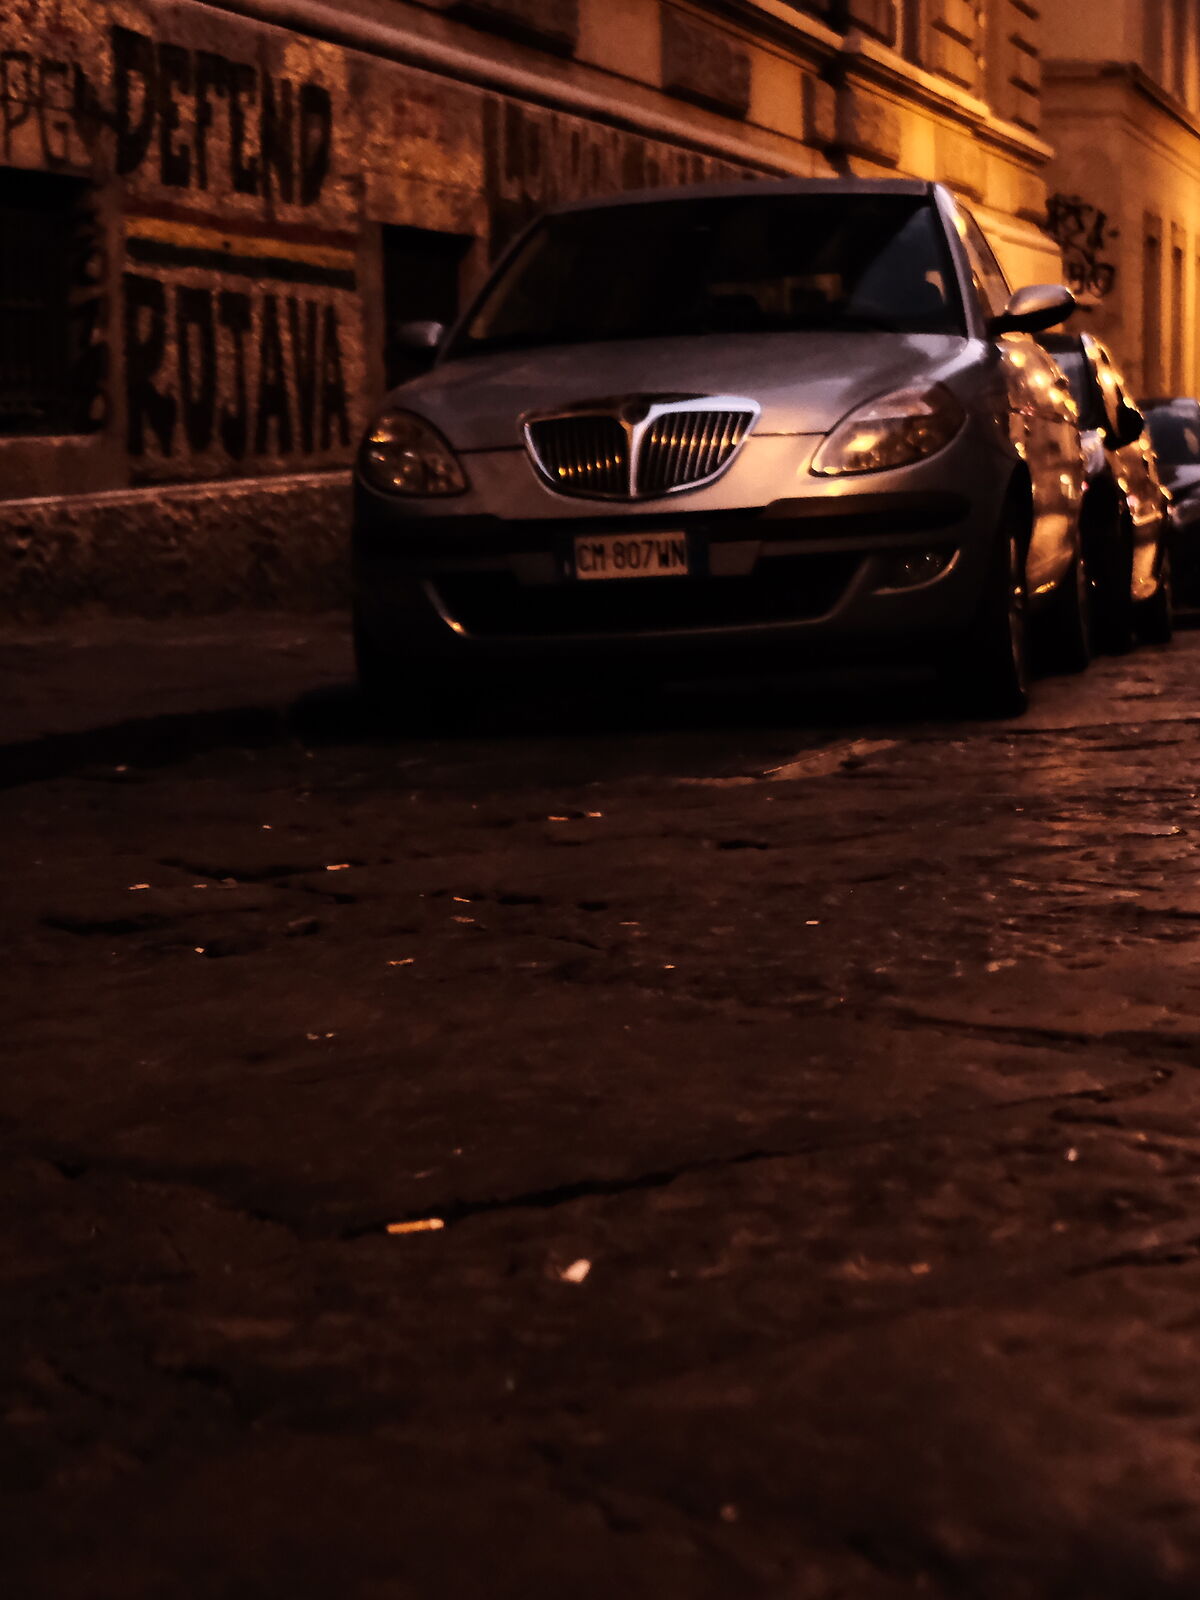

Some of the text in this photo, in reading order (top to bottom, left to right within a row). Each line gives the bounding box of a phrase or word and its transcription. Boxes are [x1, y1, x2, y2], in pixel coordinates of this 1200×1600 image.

[111, 25, 331, 205] DEFEND
[578, 539, 686, 572] CM 807WN
